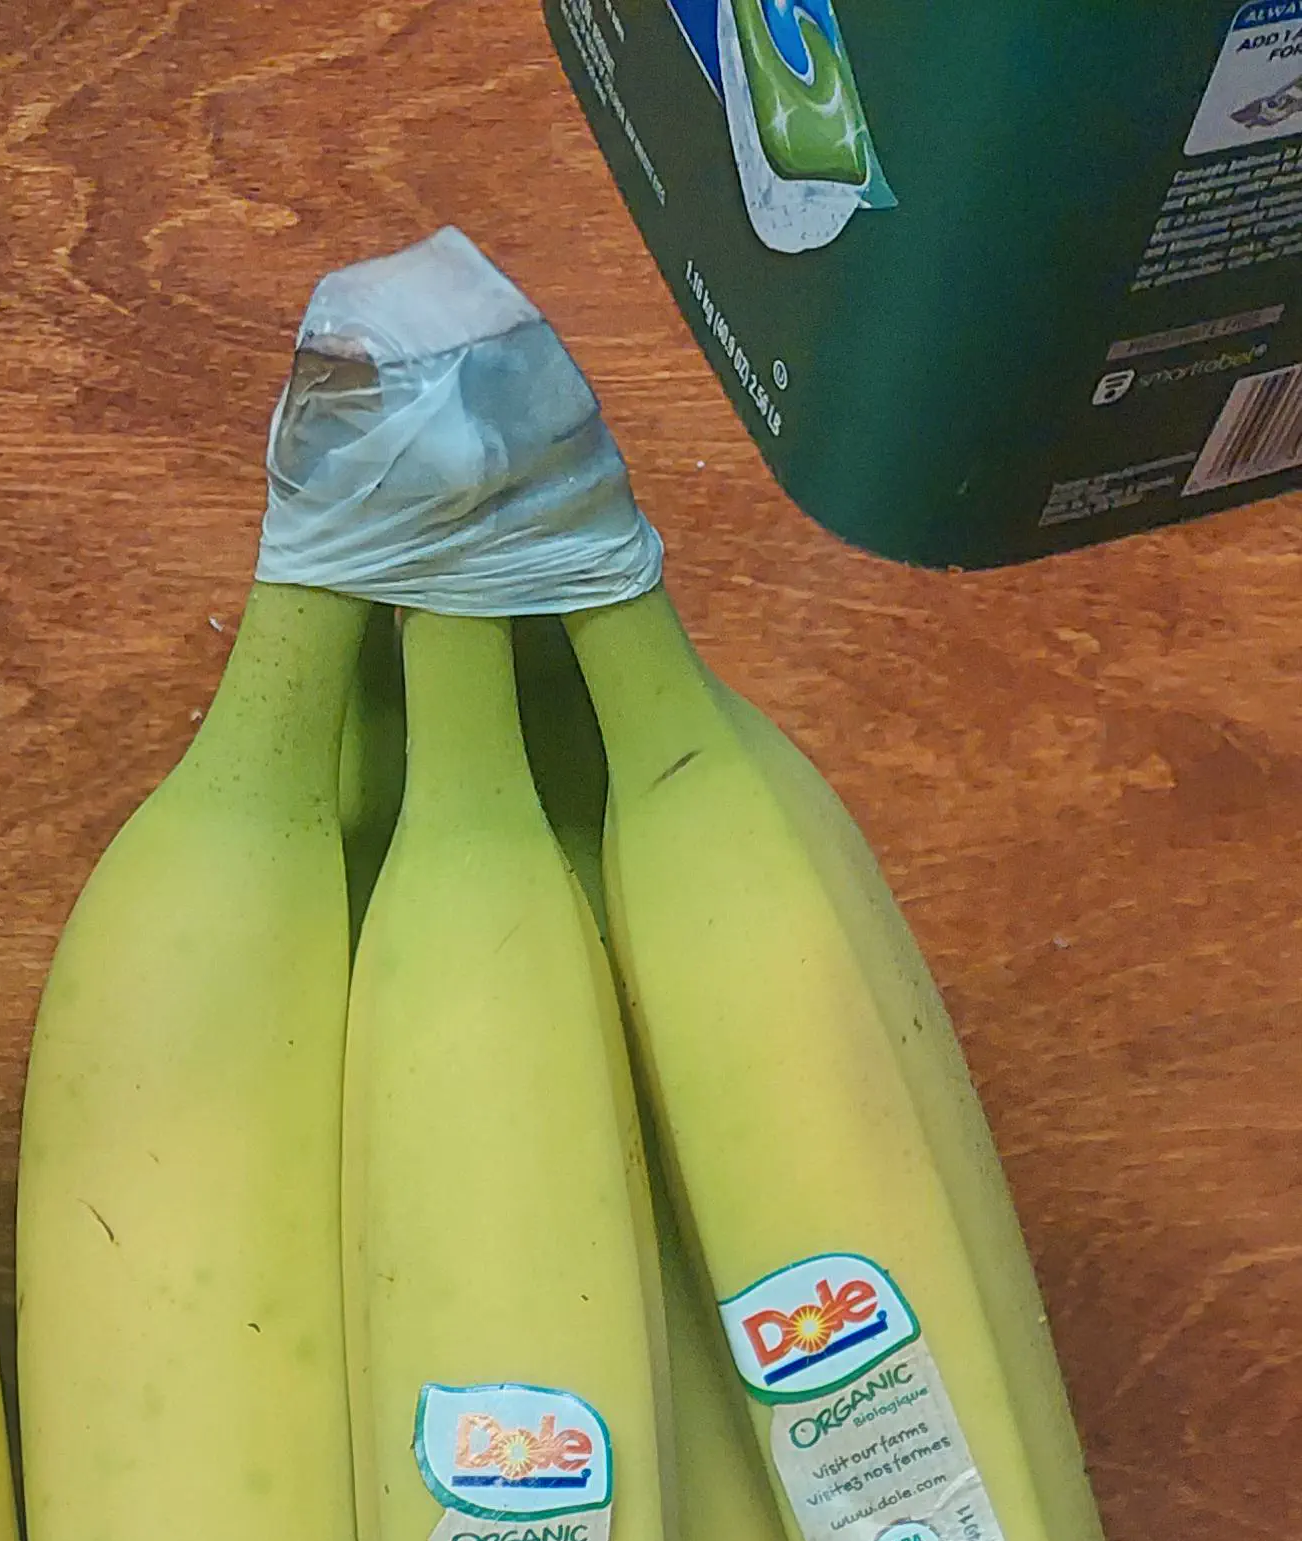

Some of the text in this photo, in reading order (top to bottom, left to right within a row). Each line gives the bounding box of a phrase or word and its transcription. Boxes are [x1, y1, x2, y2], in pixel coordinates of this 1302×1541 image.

[1244, 1, 1302, 23] ALWA
[1238, 32, 1279, 52] ADD
[766, 405, 782, 437] LB
[742, 1279, 878, 1368] Dole
[789, 1363, 914, 1448] ORGANIC
[853, 1387, 929, 1428] Biologique
[455, 1413, 594, 1480] Dole
[850, 1443, 878, 1464] our
[880, 1421, 929, 1454] farms
[864, 1462, 893, 1482] nos
[893, 1436, 951, 1472] fermes
[830, 1474, 947, 1531] www.dole.com
